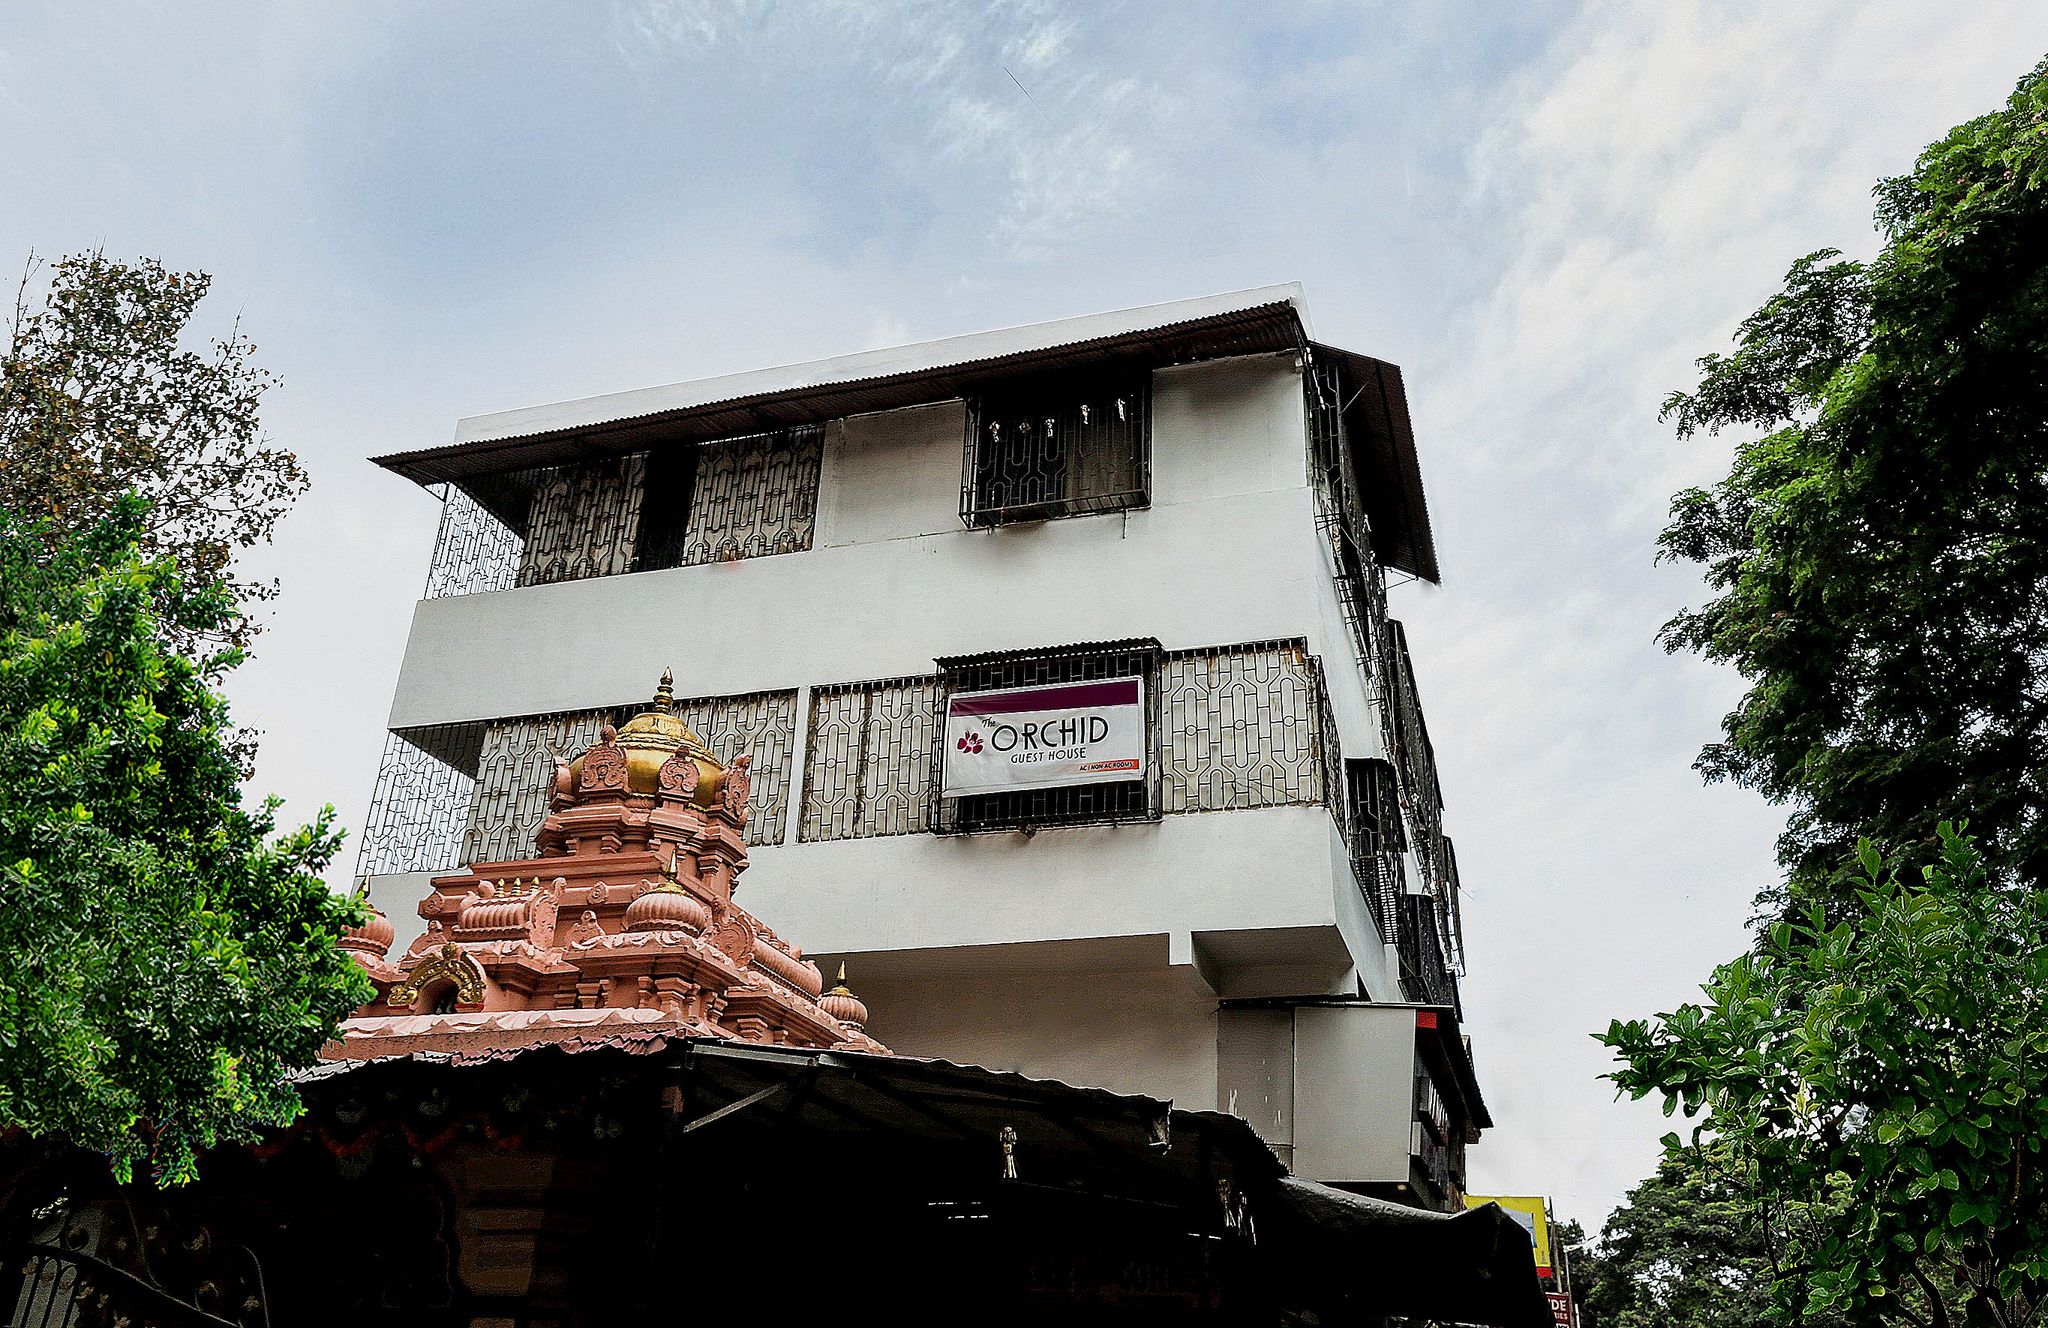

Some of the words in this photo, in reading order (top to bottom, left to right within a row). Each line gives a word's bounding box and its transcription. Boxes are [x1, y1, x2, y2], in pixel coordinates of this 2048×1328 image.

[982, 717, 996, 728] The
[992, 716, 1109, 751] ORCHID
[1011, 752, 1044, 763] GUEST
[1048, 747, 1087, 760] HOUSE
[1548, 1298, 1566, 1311] DE
